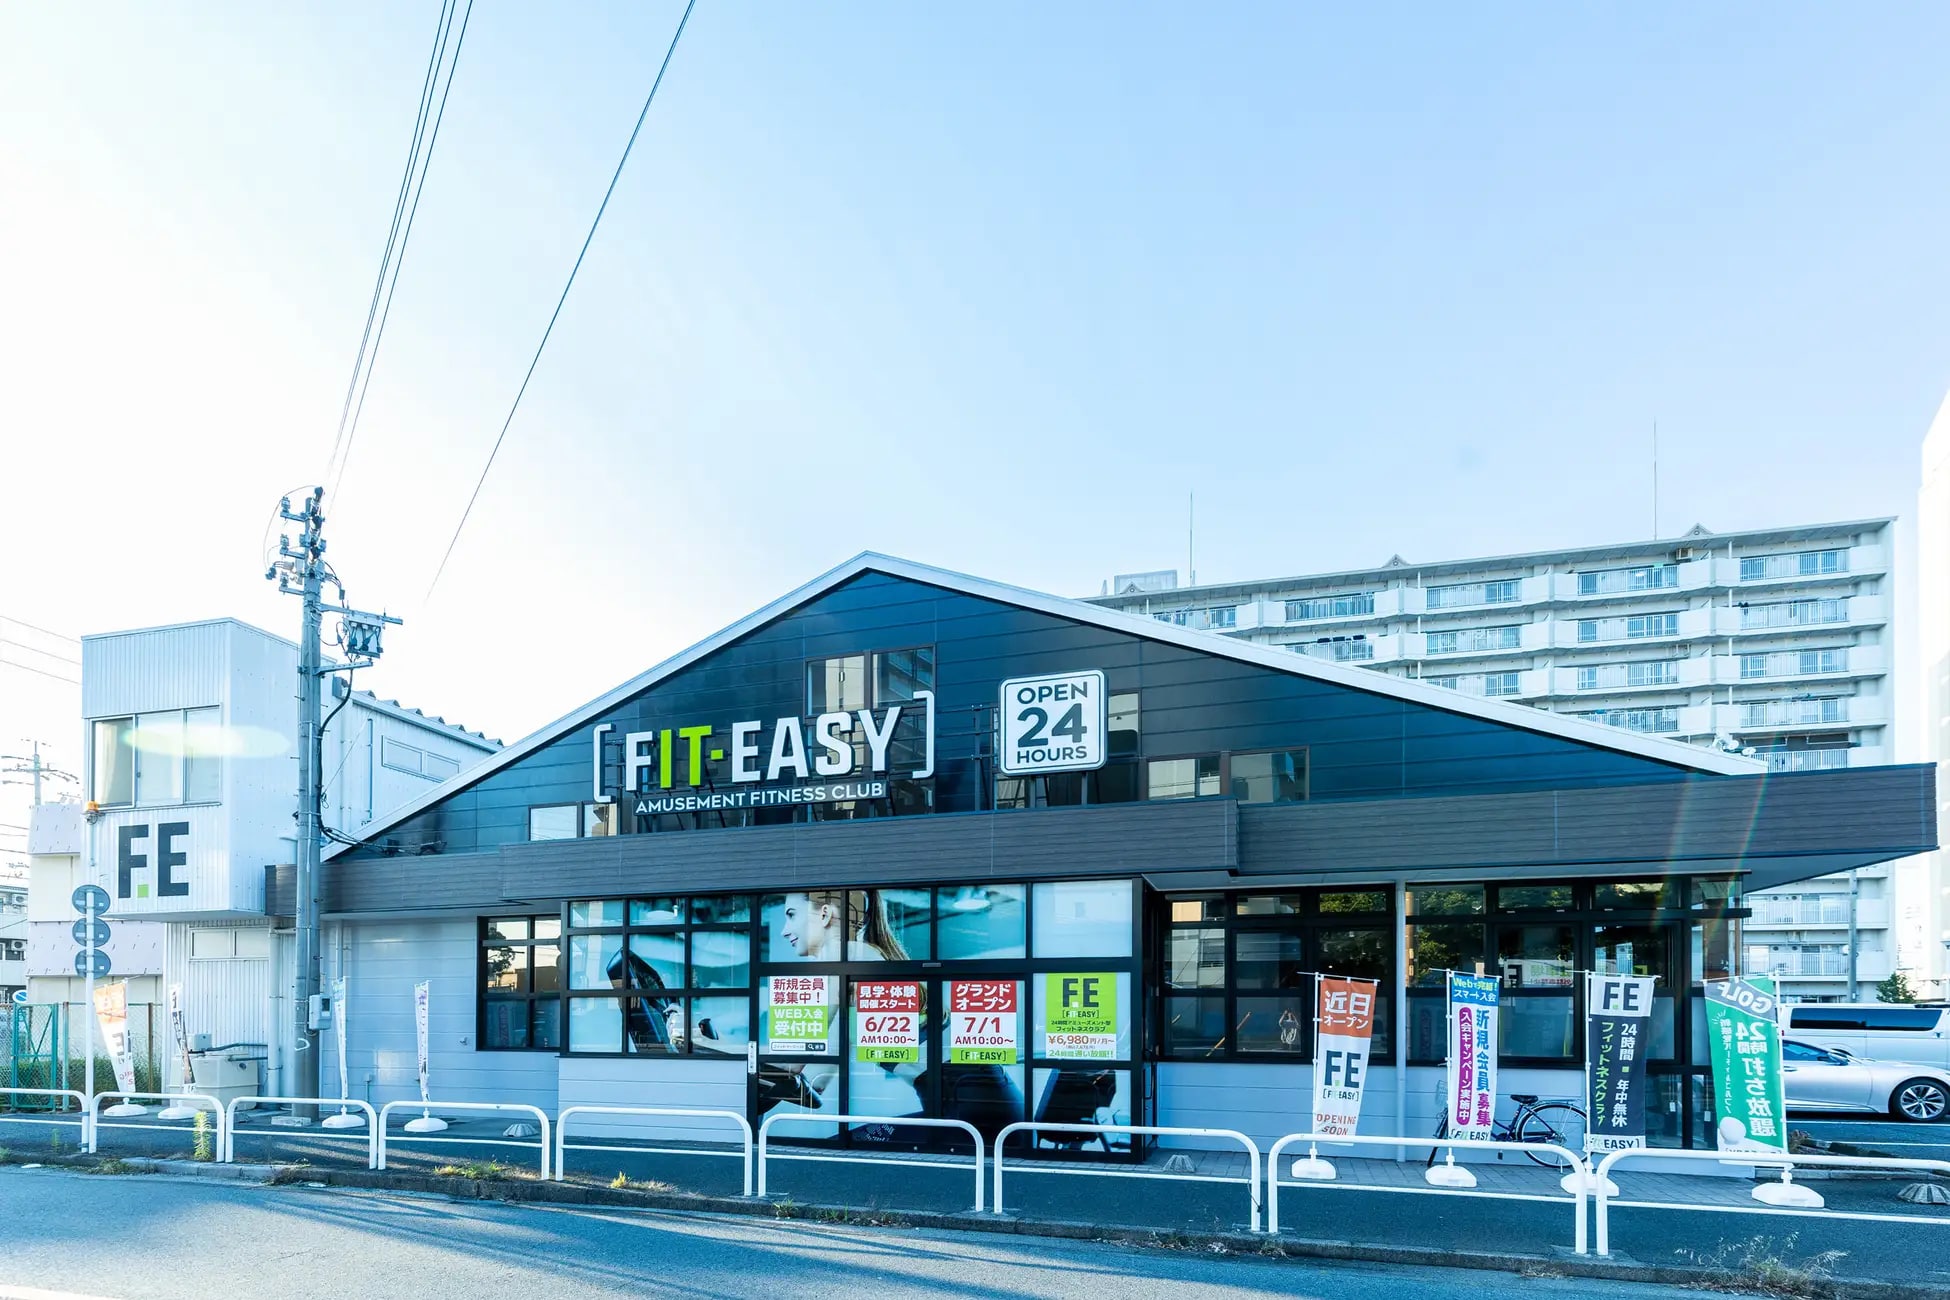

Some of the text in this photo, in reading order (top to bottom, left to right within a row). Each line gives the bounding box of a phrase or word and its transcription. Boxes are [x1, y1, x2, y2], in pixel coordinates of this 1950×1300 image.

[1017, 681, 1088, 704] OPEN
[1017, 703, 1088, 748] 24
[1017, 746, 1088, 764] HOURS
[635, 783, 883, 814] AMUSEMENT FITNESS CLUB
[774, 978, 824, 991] 新規会員
[860, 985, 917, 998] 見学・体験
[956, 983, 1011, 997] グランド
[1324, 990, 1372, 1017] 近日
[1453, 989, 1497, 1002] スマート入会
[956, 997, 1012, 1011] オープン
[774, 1008, 824, 1019] WEB入会
[775, 1020, 823, 1037] 受付中
[865, 1016, 911, 1032] 6/22
[964, 1016, 1001, 1033] 7/1
[1323, 1014, 1369, 1030] オープン
[1611, 1023, 1638, 1128] 24時間 年中無休
[1321, 1125, 1348, 1136] SOON
